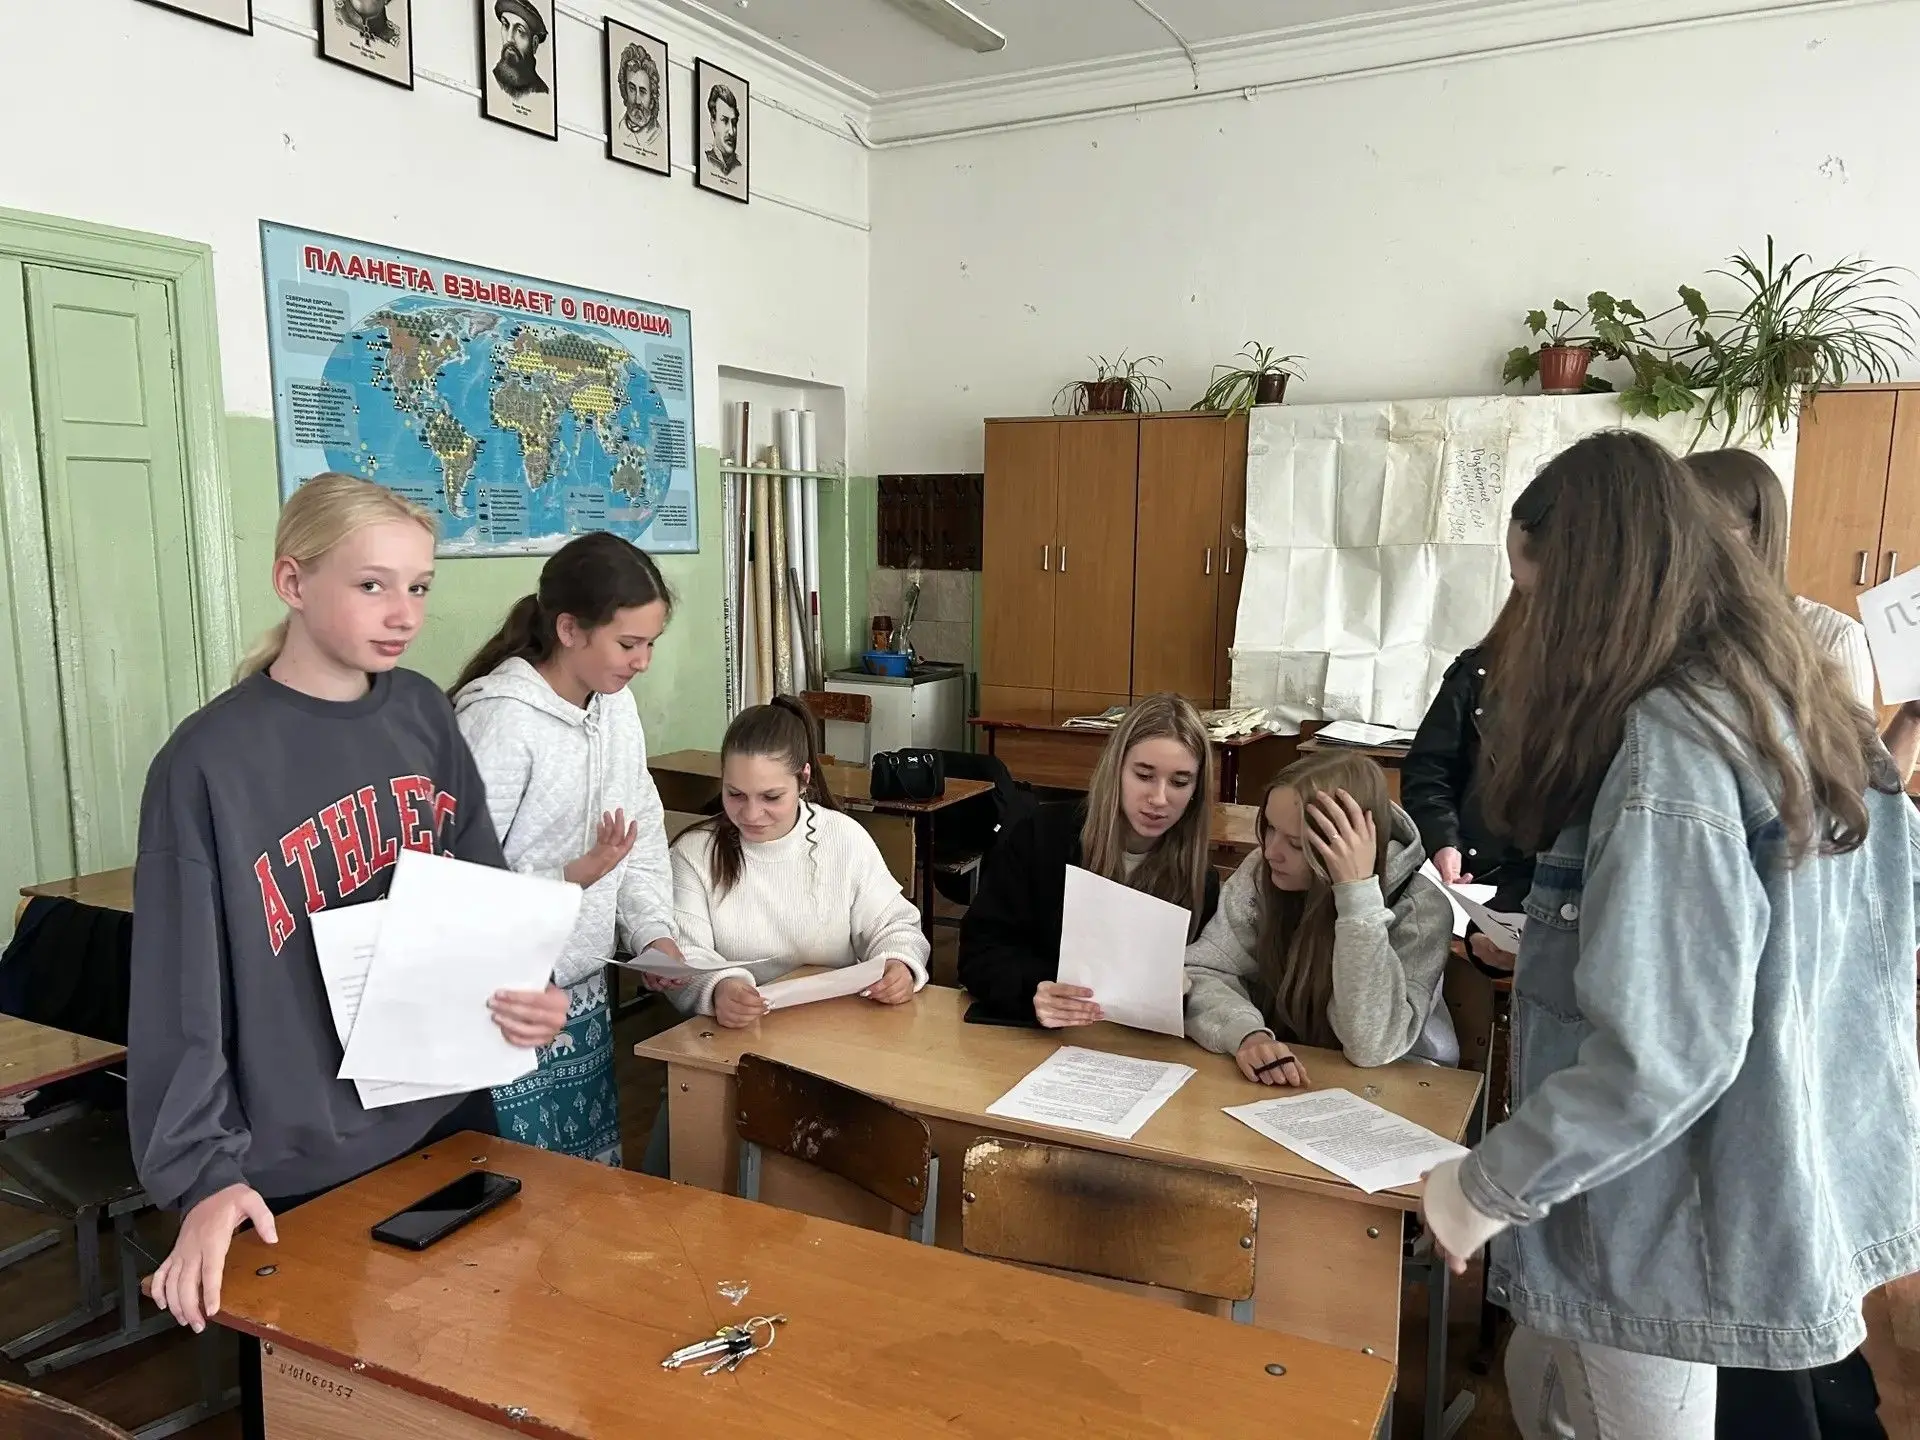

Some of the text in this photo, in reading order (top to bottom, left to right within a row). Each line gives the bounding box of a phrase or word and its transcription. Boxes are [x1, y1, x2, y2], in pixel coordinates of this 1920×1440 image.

[303, 245, 673, 336] ПЛАНЕТА ВЗЫВАЕТ О ПОМОЩИ
[1488, 451, 1502, 494] СССР
[253, 774, 457, 957] ATHLE
